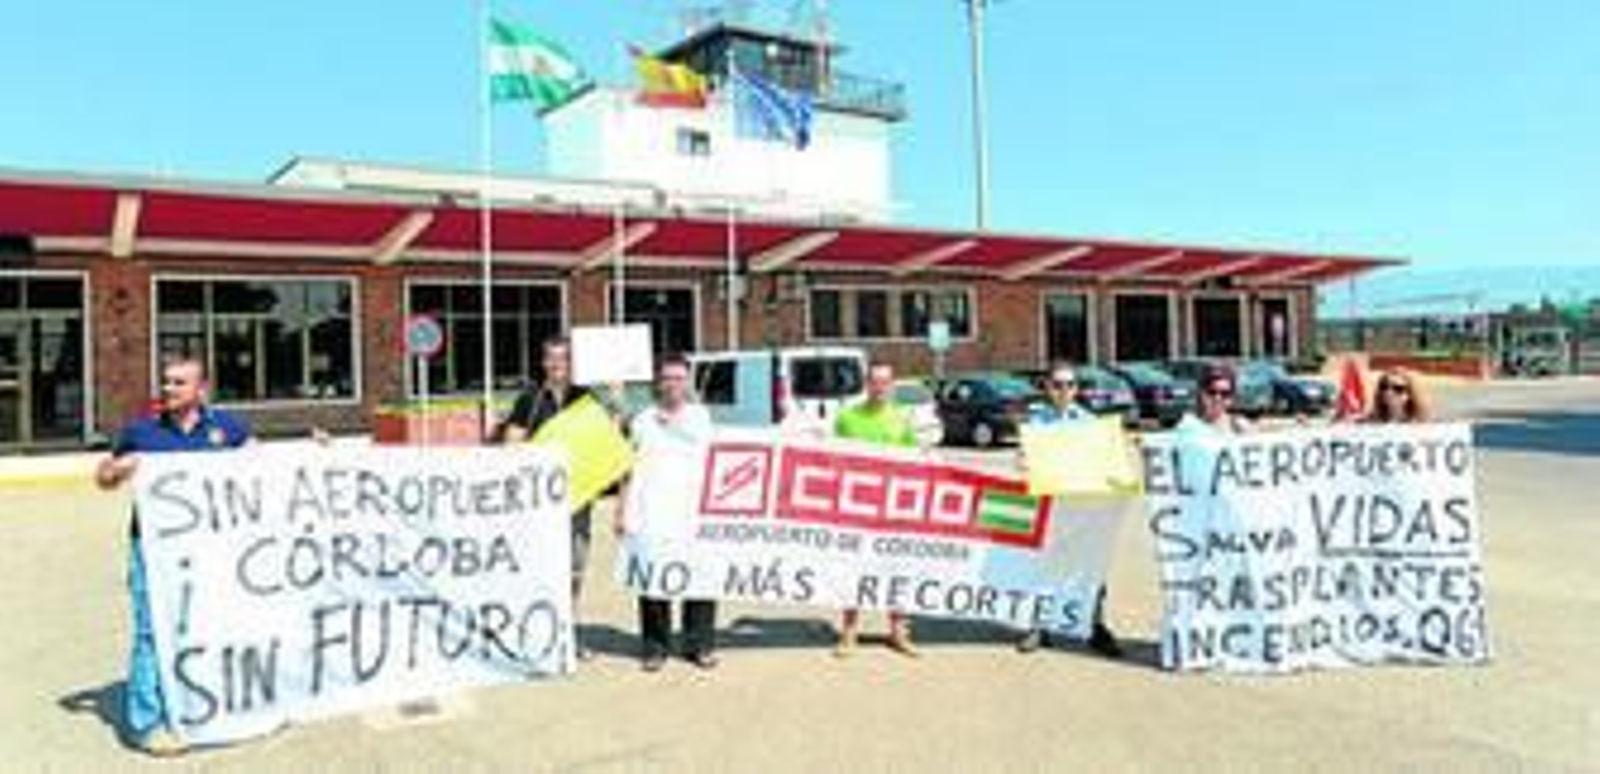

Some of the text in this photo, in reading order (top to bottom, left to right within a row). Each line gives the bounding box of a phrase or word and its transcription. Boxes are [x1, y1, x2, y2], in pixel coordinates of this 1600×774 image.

[1144, 438, 1469, 496] EL AEROPUERTO
[149, 464, 568, 539] SIN AEROPUERTO
[1309, 493, 1471, 550] VIDAS
[625, 552, 1082, 630] NO MÁS RECORTES
[1160, 560, 1481, 613] TRASPLANTES
[173, 637, 281, 725] SIN
